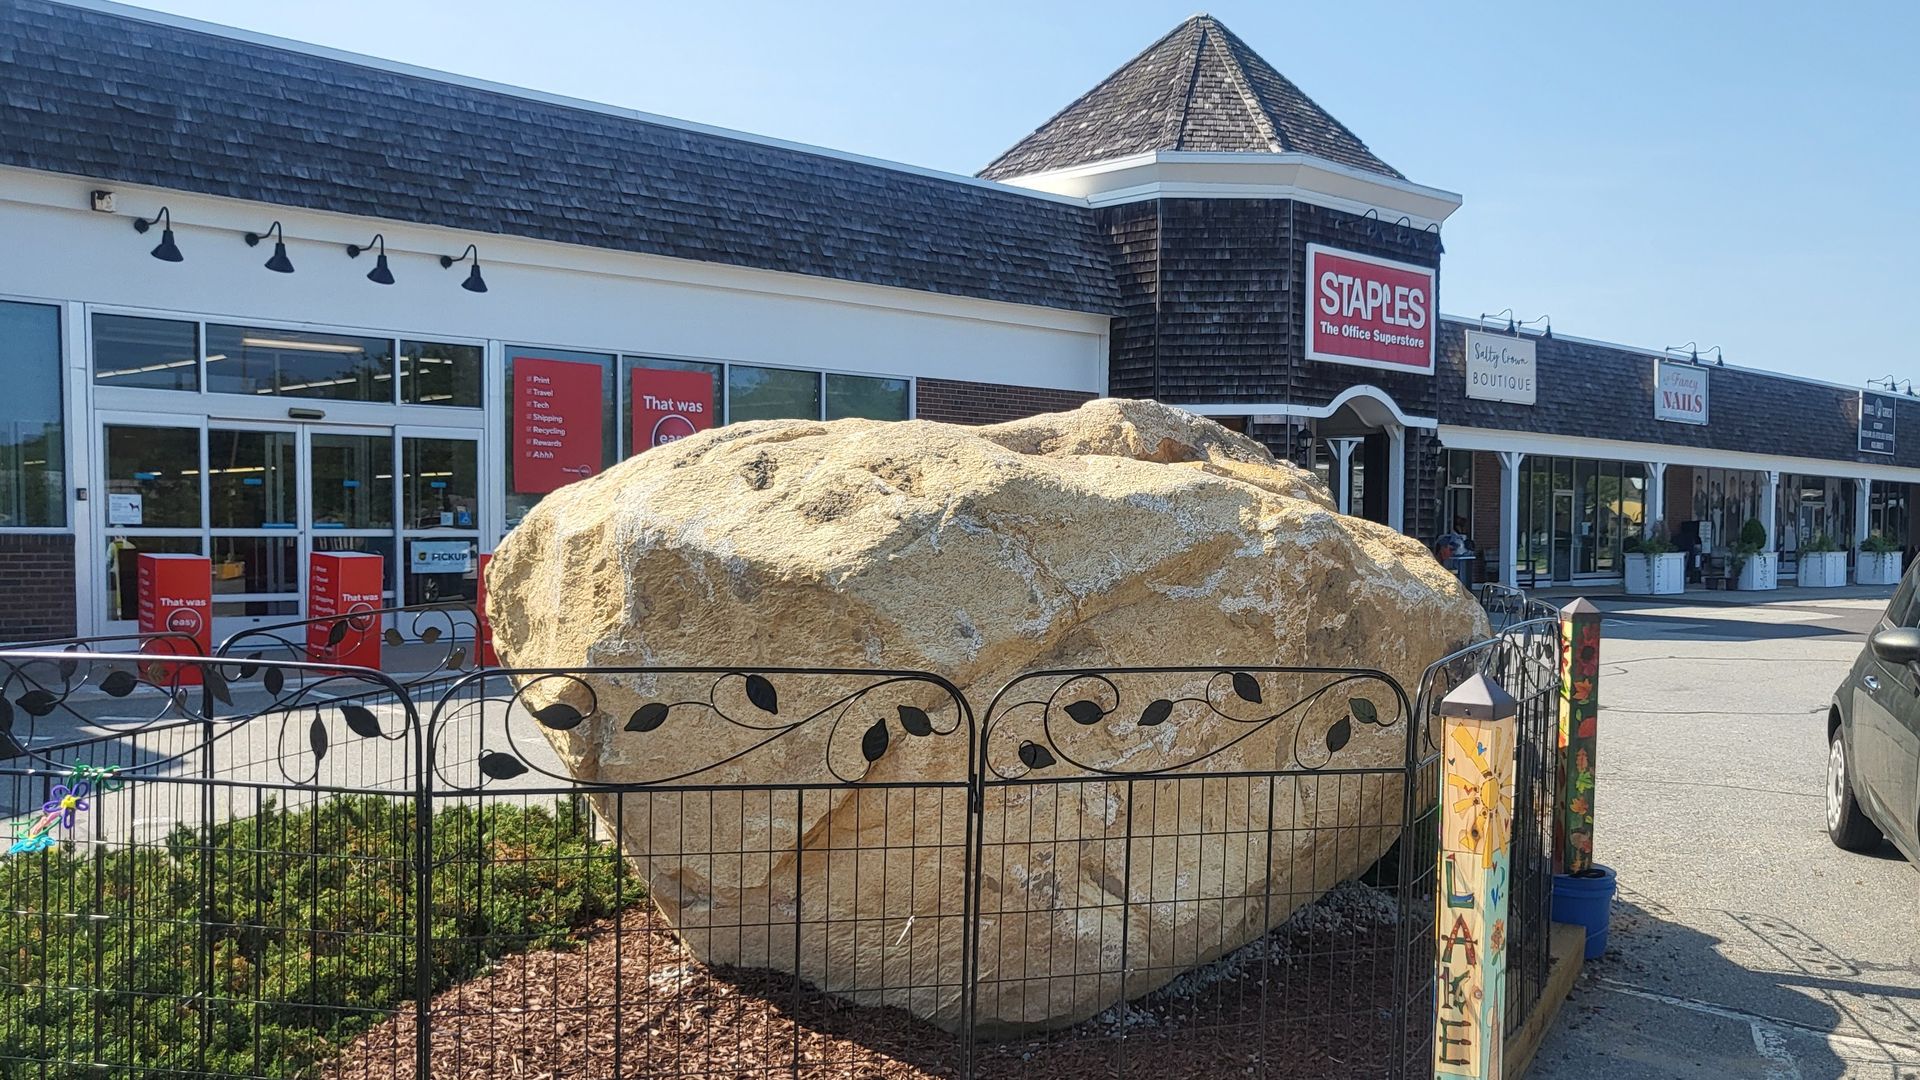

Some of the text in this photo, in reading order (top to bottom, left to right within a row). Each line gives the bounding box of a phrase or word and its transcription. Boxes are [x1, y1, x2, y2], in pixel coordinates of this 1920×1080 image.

[1320, 271, 1426, 330] STAPLES
[1320, 321, 1424, 348] The Office Superstore
[1474, 342, 1529, 369] Salty Crown
[533, 376, 550, 384] Print
[1473, 371, 1532, 391] BOUTIQUE
[533, 388, 554, 397] Travel
[533, 400, 550, 409] Tech
[643, 395, 703, 413] That was
[1662, 391, 1702, 413] NAILS
[533, 413, 563, 423] Shipping
[533, 425, 566, 436] Recycling
[533, 438, 562, 447] Rewards
[532, 451, 554, 459] Ahhh
[431, 552, 468, 561] PICKUP
[160, 597, 207, 607] That was
[342, 593, 361, 602] That
[172, 618, 197, 628] easy
[1439, 853, 1478, 1066] LAKE
